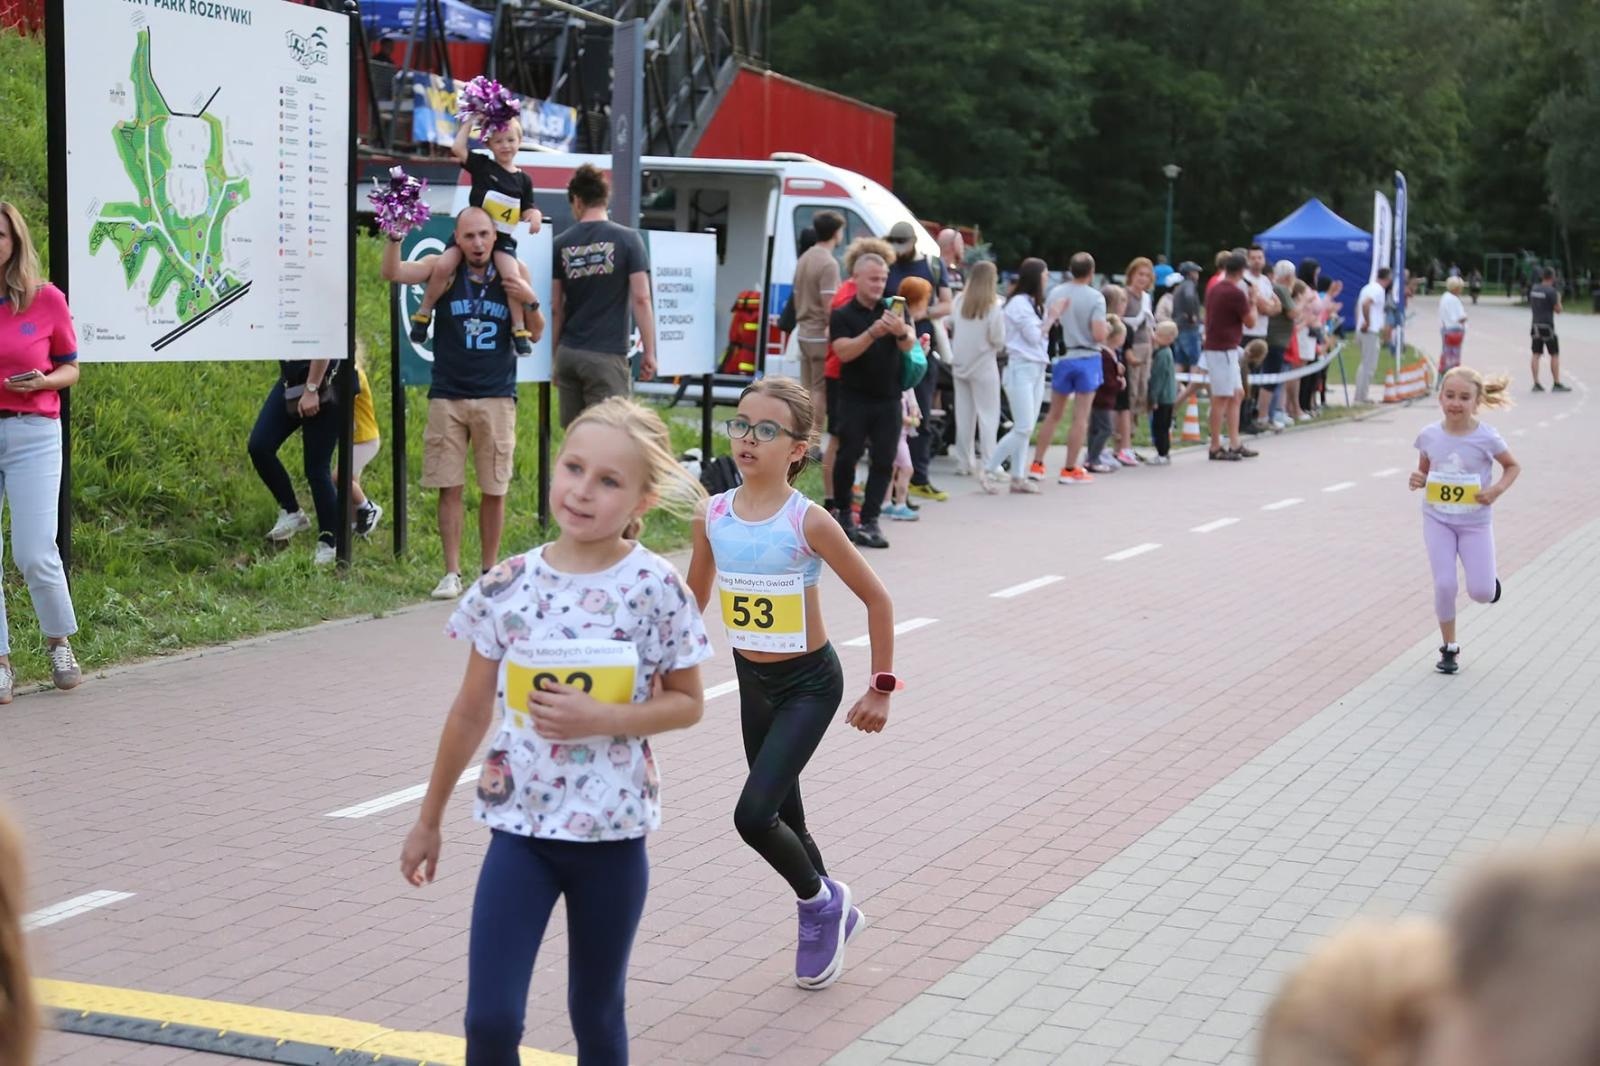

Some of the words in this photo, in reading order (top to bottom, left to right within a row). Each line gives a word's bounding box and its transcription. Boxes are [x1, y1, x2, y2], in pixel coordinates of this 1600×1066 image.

[189, 1, 252, 26] ROZRYWKI
[500, 208, 513, 222] 4
[464, 320, 498, 349] 12
[1440, 485, 1464, 502] 89
[733, 596, 774, 629] 53
